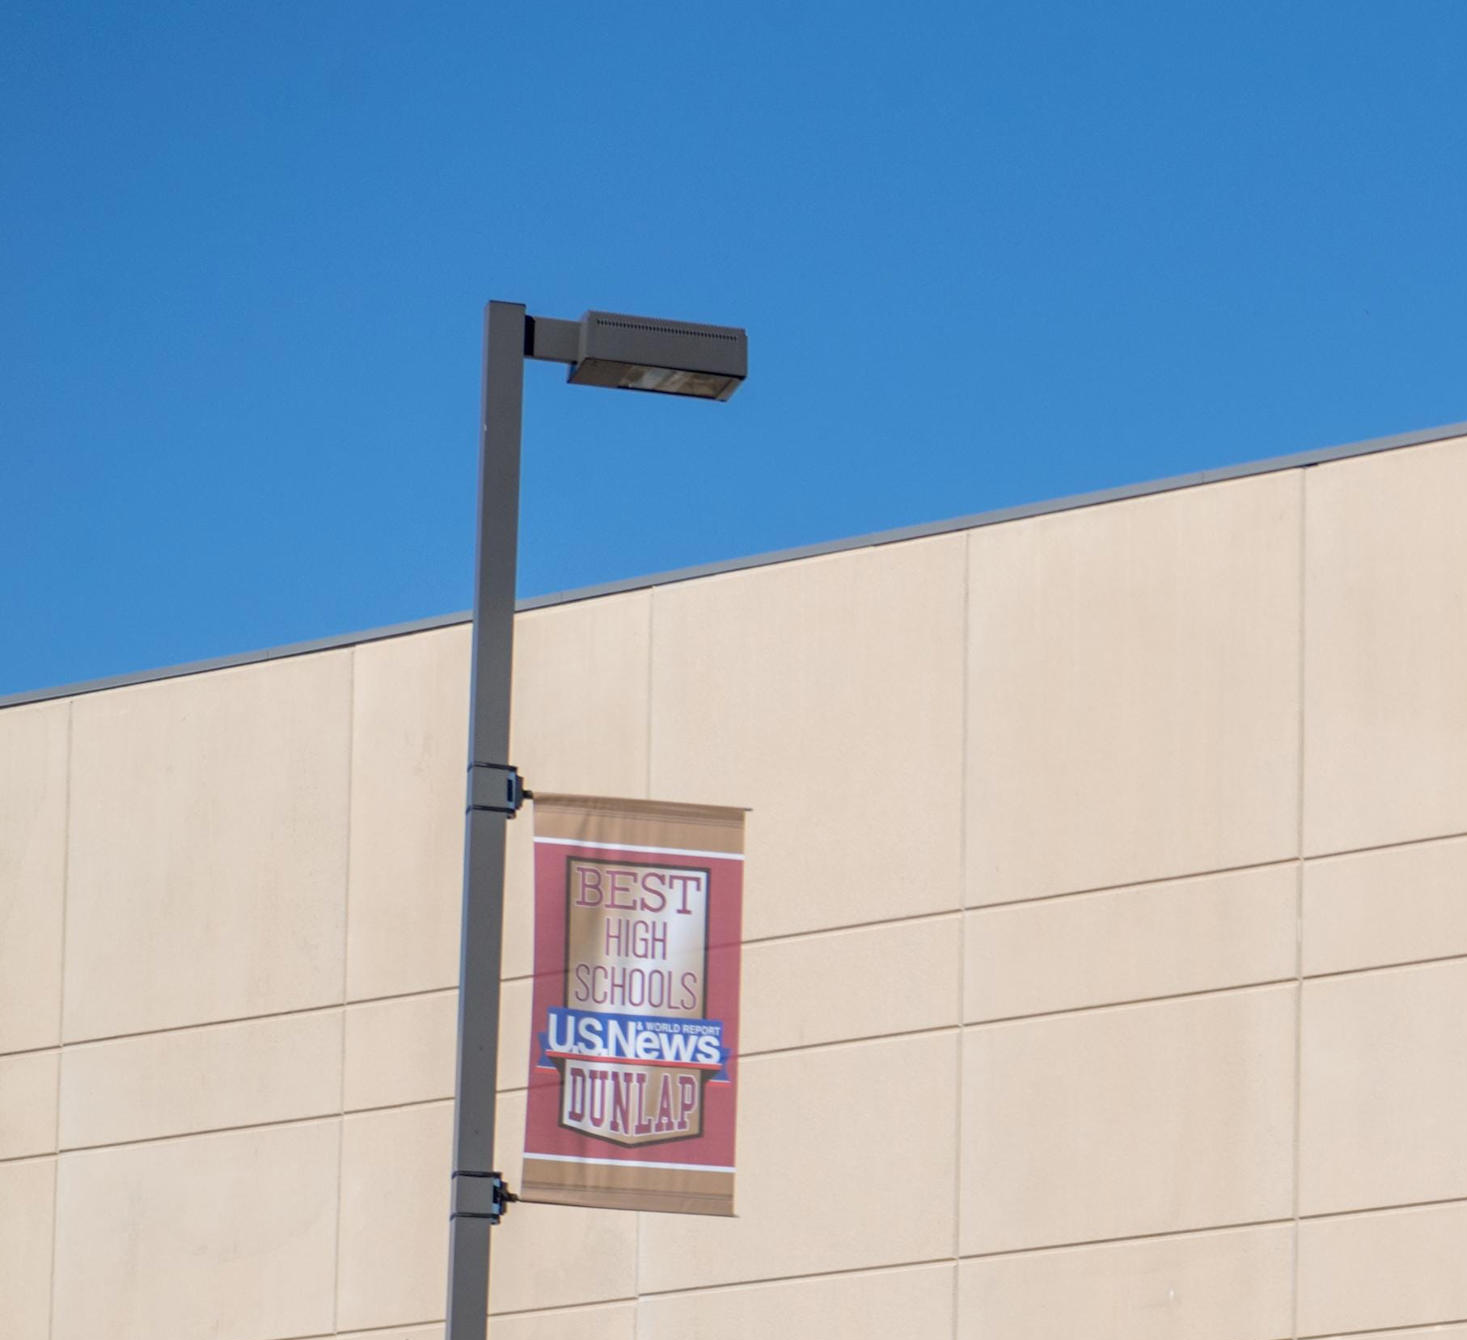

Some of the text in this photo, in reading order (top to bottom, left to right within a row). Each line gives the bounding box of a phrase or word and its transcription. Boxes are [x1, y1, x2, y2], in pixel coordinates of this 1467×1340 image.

[575, 866, 701, 915] BEST
[604, 918, 668, 960] HIGH
[574, 963, 698, 1010] SCHOOLS
[646, 1022, 681, 1033] WORLD
[683, 1024, 721, 1036] REPORT
[568, 1067, 697, 1136] DUNLAP
